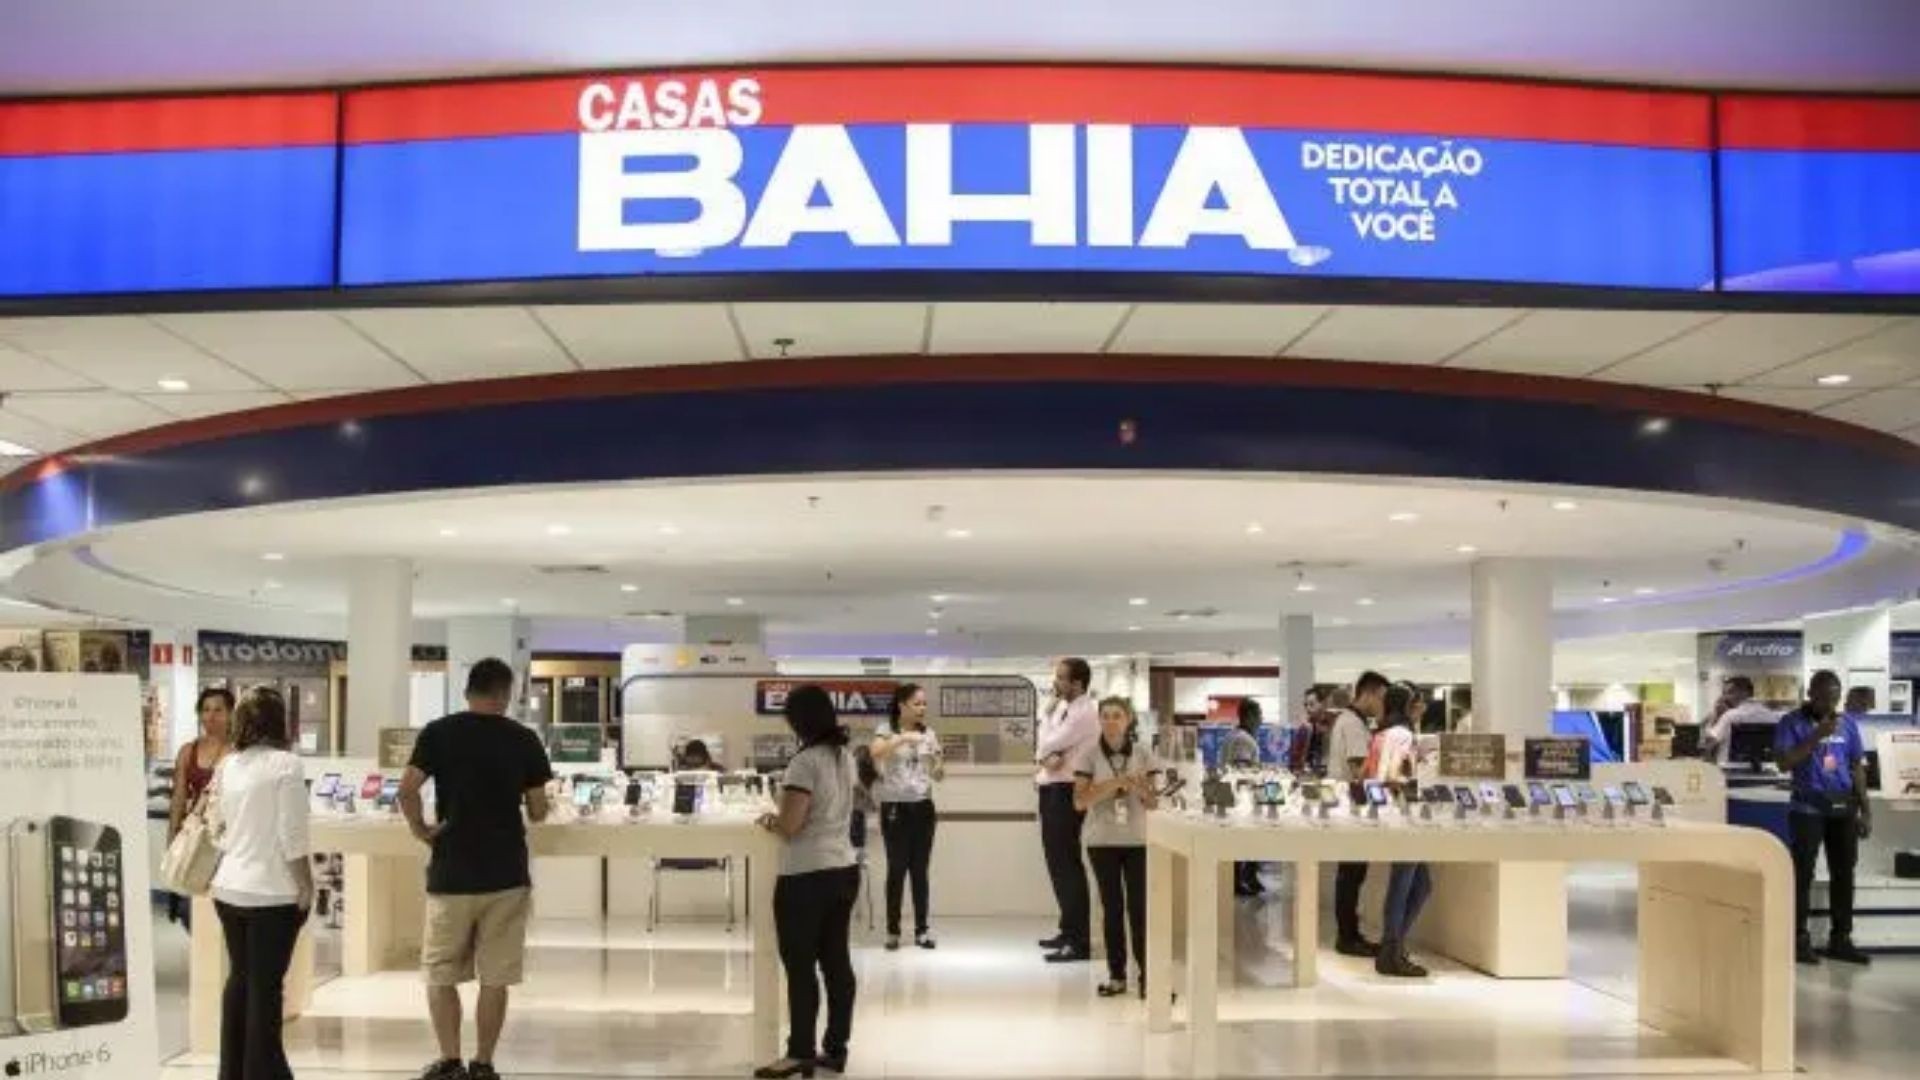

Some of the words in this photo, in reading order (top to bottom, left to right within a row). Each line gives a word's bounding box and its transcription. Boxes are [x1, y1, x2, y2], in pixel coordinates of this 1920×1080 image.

[578, 78, 763, 131] CASAS
[1302, 141, 1483, 178] DEDICAÇÃO
[578, 124, 1298, 250] BAHIA
[1328, 177, 1430, 207] TOTAL
[1434, 182, 1458, 208] A
[1351, 208, 1435, 241] VOCÊ
[24, 1050, 94, 1075] iPhone
[96, 1041, 111, 1063] 6
